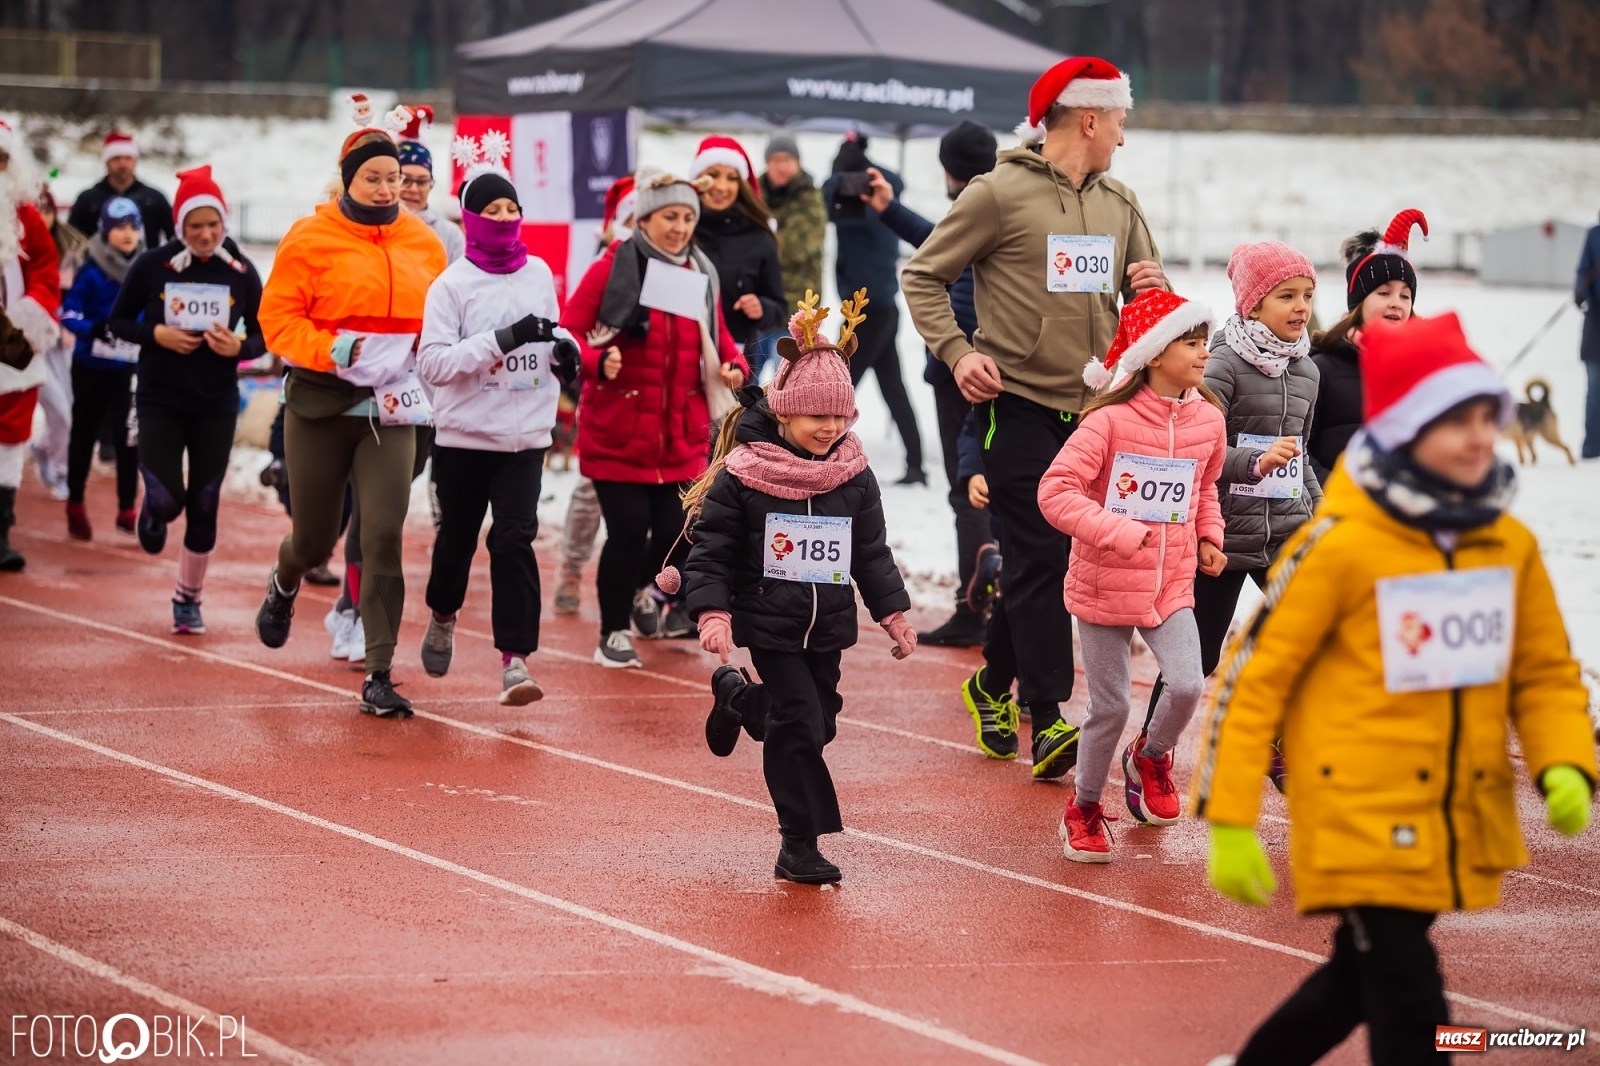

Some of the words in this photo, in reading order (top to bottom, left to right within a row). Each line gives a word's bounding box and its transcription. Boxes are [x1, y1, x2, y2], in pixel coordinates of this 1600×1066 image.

[787, 77, 974, 113] www.raciborz.pl
[1075, 255, 1109, 274] 030
[187, 300, 220, 317] 015
[506, 353, 538, 372] 018
[1140, 480, 1186, 503] 079
[797, 539, 841, 562] 185
